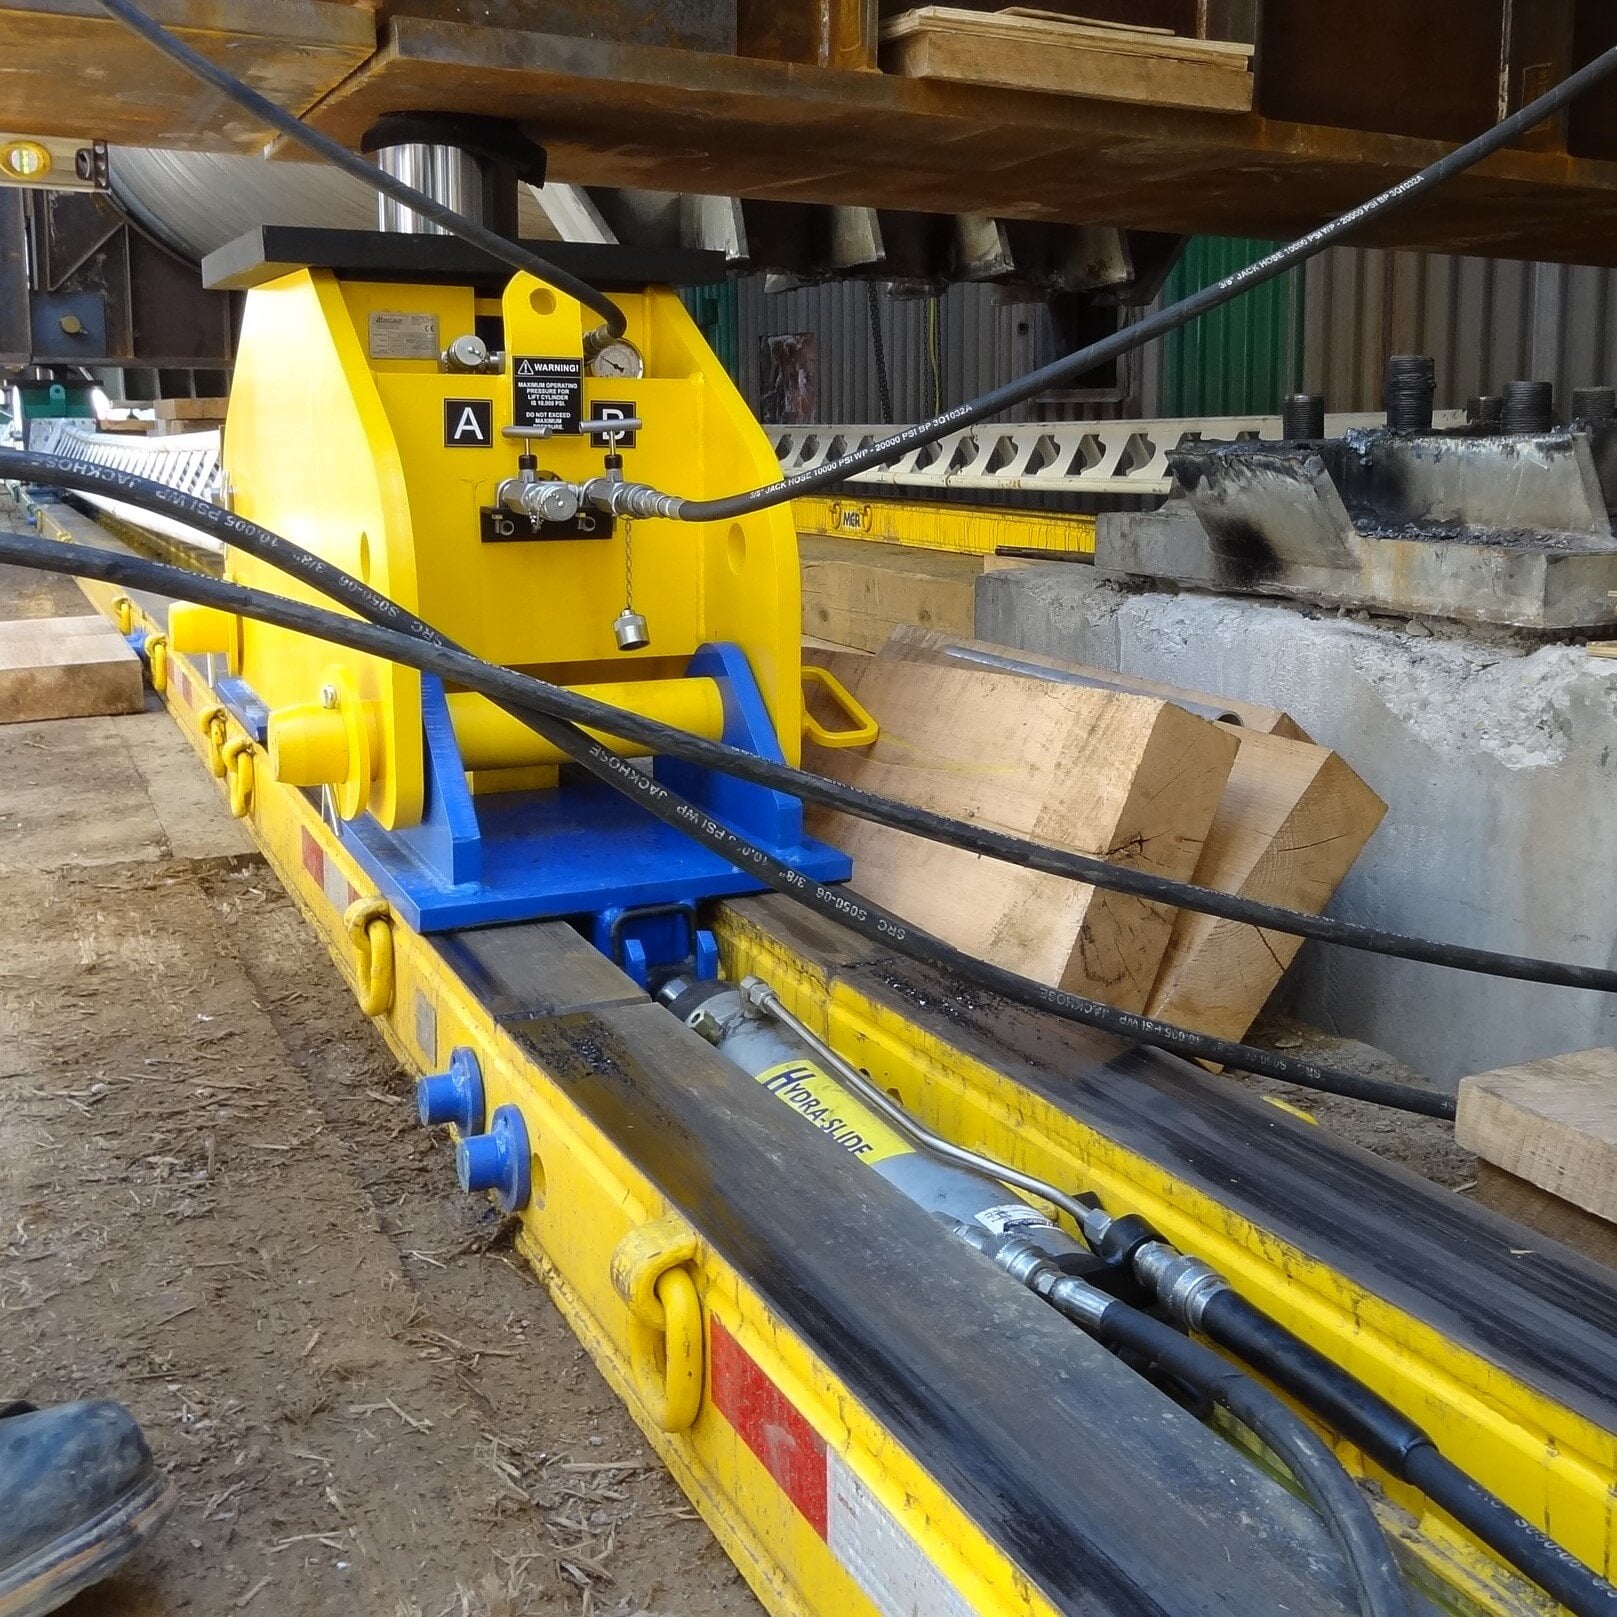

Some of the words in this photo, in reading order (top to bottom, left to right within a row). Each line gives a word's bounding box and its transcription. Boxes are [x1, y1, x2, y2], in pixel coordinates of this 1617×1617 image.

[1236, 264, 1260, 280] JACK
[1259, 251, 1285, 268] HOSE
[1284, 239, 1308, 254] 10000
[1307, 231, 1323, 242] PSI
[1340, 208, 1364, 224] 20000
[1363, 200, 1379, 212] PSI
[1377, 193, 1389, 204] BP
[534, 363, 579, 372] WARNING!
[454, 406, 484, 440] A
[765, 481, 787, 494] JACK
[788, 471, 812, 486] HOSE
[813, 462, 837, 477] 10000
[838, 456, 853, 467] PSI
[854, 449, 869, 460] WP
[875, 436, 901, 452] 20000
[902, 429, 917, 441] PSI
[919, 422, 932, 433] BP
[933, 404, 973, 427] 3Q1032A
[156, 488, 186, 507] WP
[190, 499, 222, 522] PSI
[410, 621, 444, 648] SRC
[589, 744, 668, 800] JACKHOSE
[676, 805, 700, 824] WP
[701, 819, 726, 840] PSI
[815, 887, 868, 922] S050-06
[877, 919, 906, 940] SRC
[1119, 1016, 1139, 1031] WP
[761, 1067, 874, 1155] HYDRA-SLIDE
